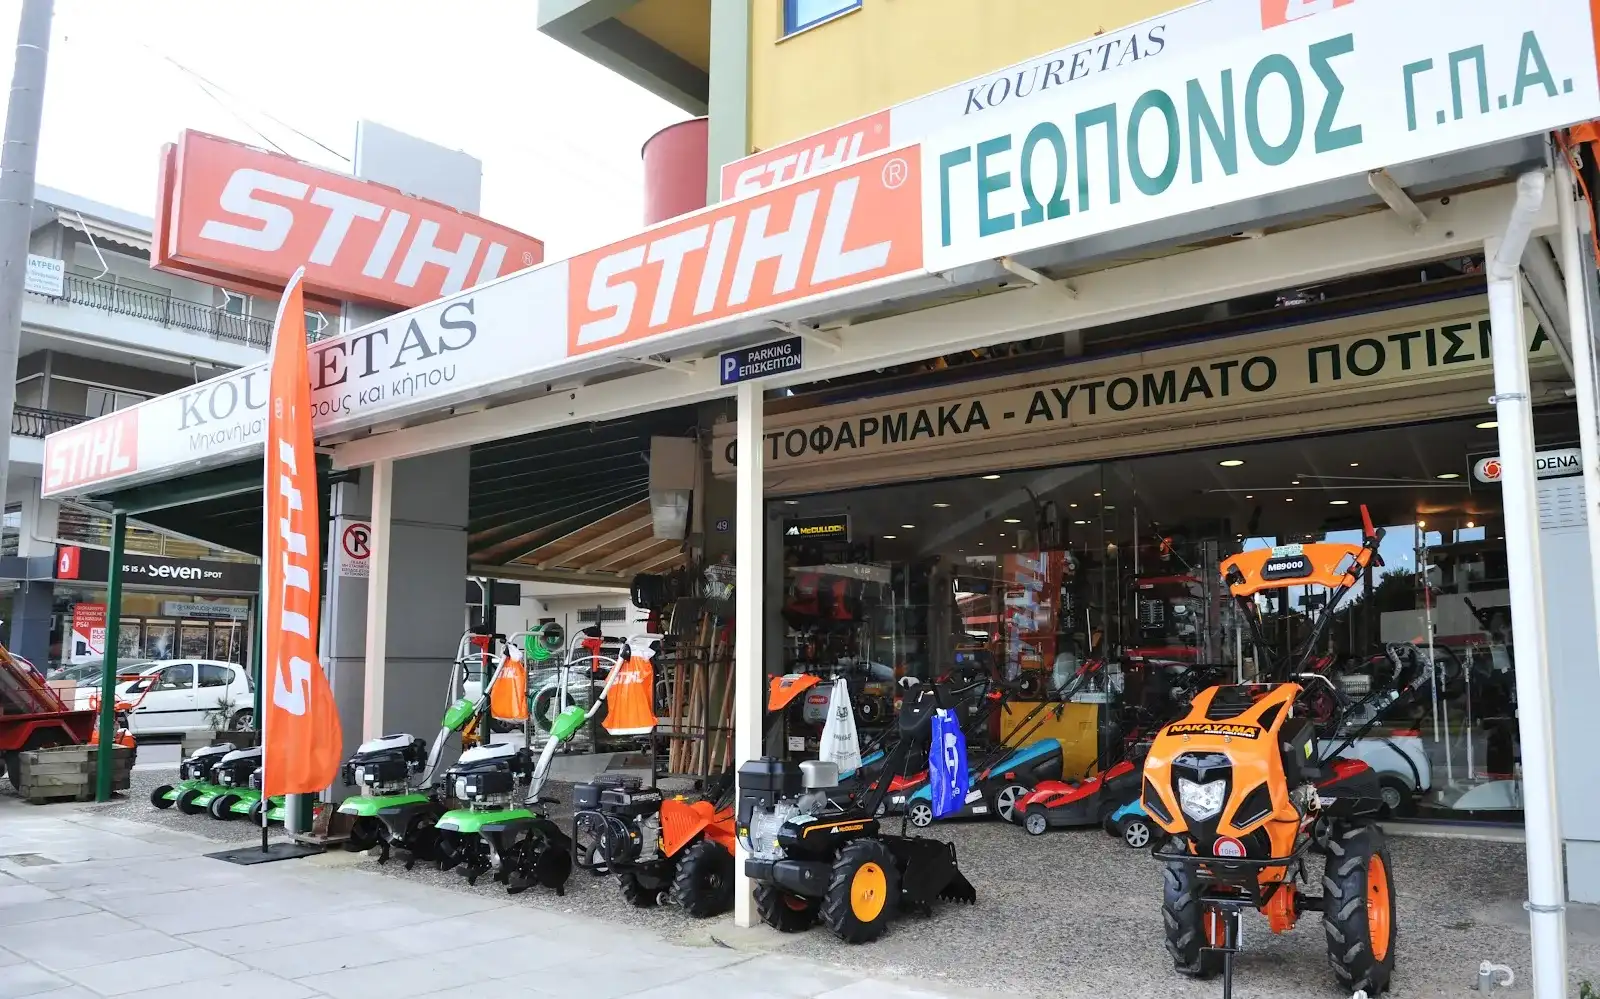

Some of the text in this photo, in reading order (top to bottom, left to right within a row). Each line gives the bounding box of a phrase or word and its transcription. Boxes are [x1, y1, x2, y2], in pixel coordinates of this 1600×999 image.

[963, 24, 1166, 116] KOURETAS
[939, 30, 1573, 247] ΓΕΩΠΟΝΟΣ Γ.Π.Α.
[576, 175, 892, 346] STIHL
[177, 298, 478, 432] KOUETAS
[724, 357, 737, 381] P
[739, 353, 801, 377] ΕΠΙΣΚΕΠΤΩΝ
[748, 343, 792, 363] PARKING
[188, 417, 266, 453] Μηχανήμα
[359, 384, 386, 407] και
[392, 364, 456, 397] κήπου
[725, 400, 990, 467] ΦΤΟΦΑΡΜΑΚΑ
[1025, 355, 1278, 425] ΑΥΤΟΜΑΤΟ
[46, 420, 131, 489] STIHL
[716, 520, 728, 531] 49
[131, 565, 139, 573] IS
[203, 570, 223, 579] SPOT
[1267, 560, 1304, 572] MB9000
[1171, 724, 1256, 735] NAKAYAMA
